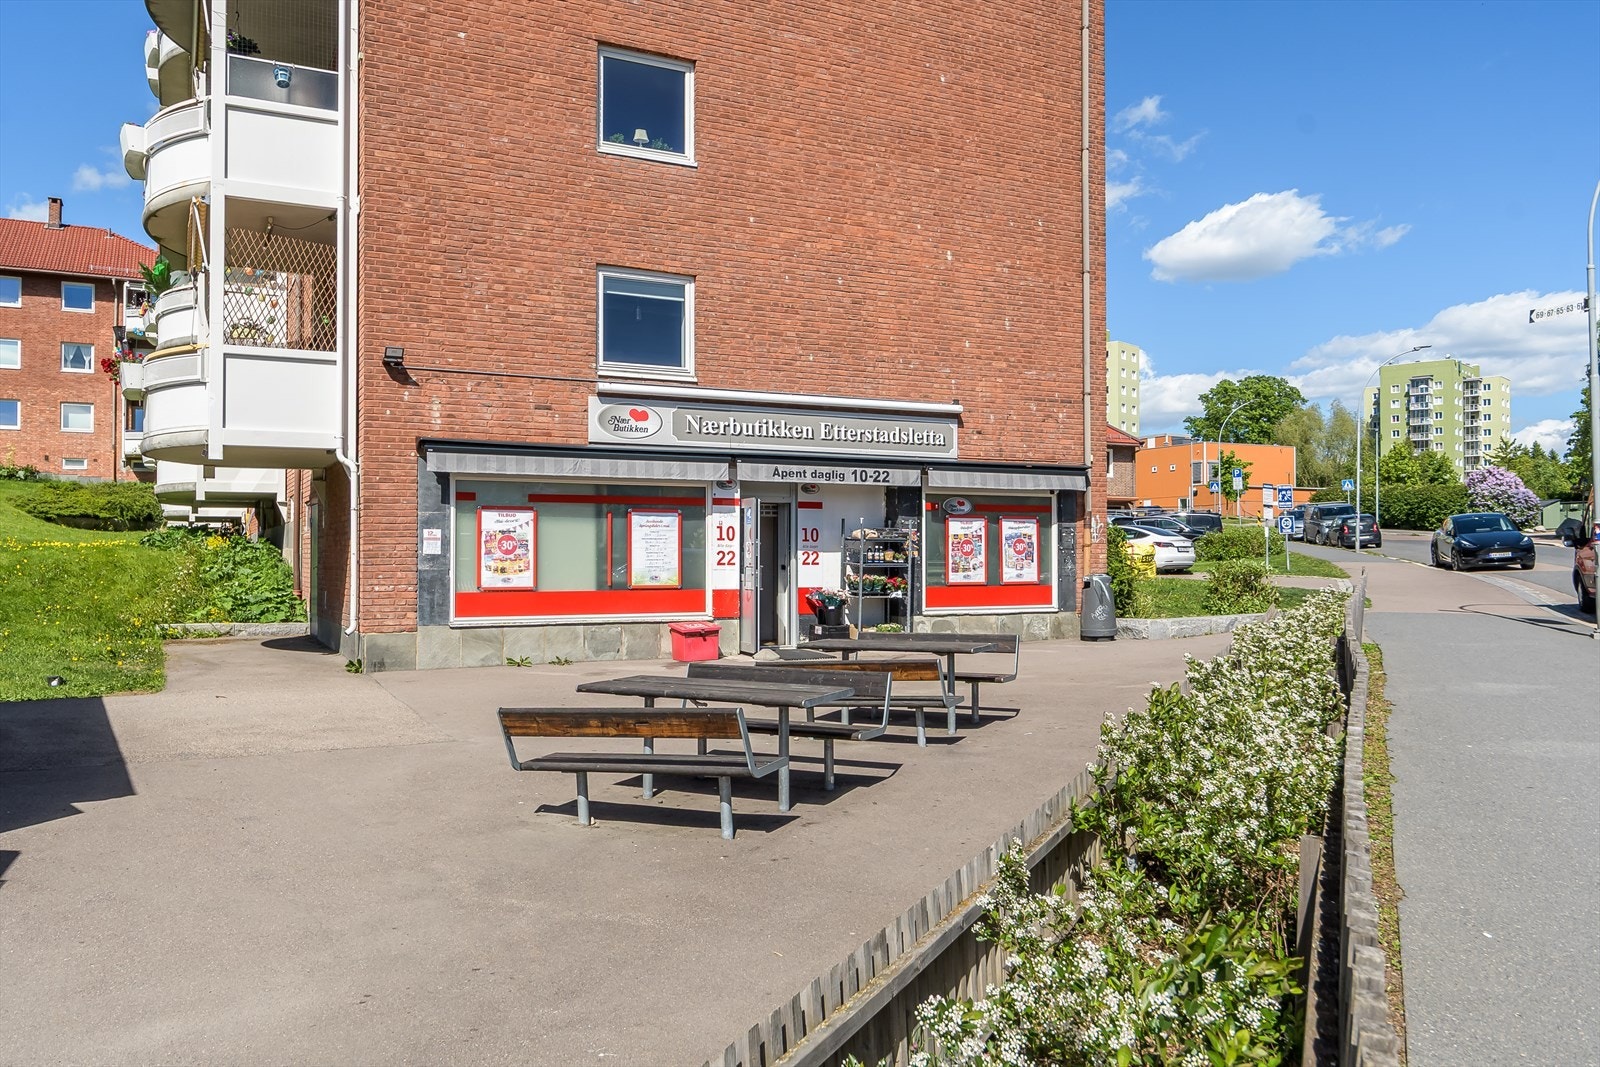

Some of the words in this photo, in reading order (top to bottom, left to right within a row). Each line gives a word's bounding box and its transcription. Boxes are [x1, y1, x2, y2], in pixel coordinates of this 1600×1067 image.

[608, 415, 632, 426] Nær
[613, 423, 649, 434] Butikken
[685, 414, 814, 440] Nærbutikken
[819, 421, 946, 447] Etterstadsletta
[772, 465, 808, 481] Åpent
[810, 468, 846, 482] daglig
[850, 469, 891, 484] 10-22
[716, 525, 736, 541] 10
[801, 527, 819, 542] 10
[498, 540, 517, 550] -30%
[716, 550, 736, 566] 22
[801, 550, 820, 566] 22
